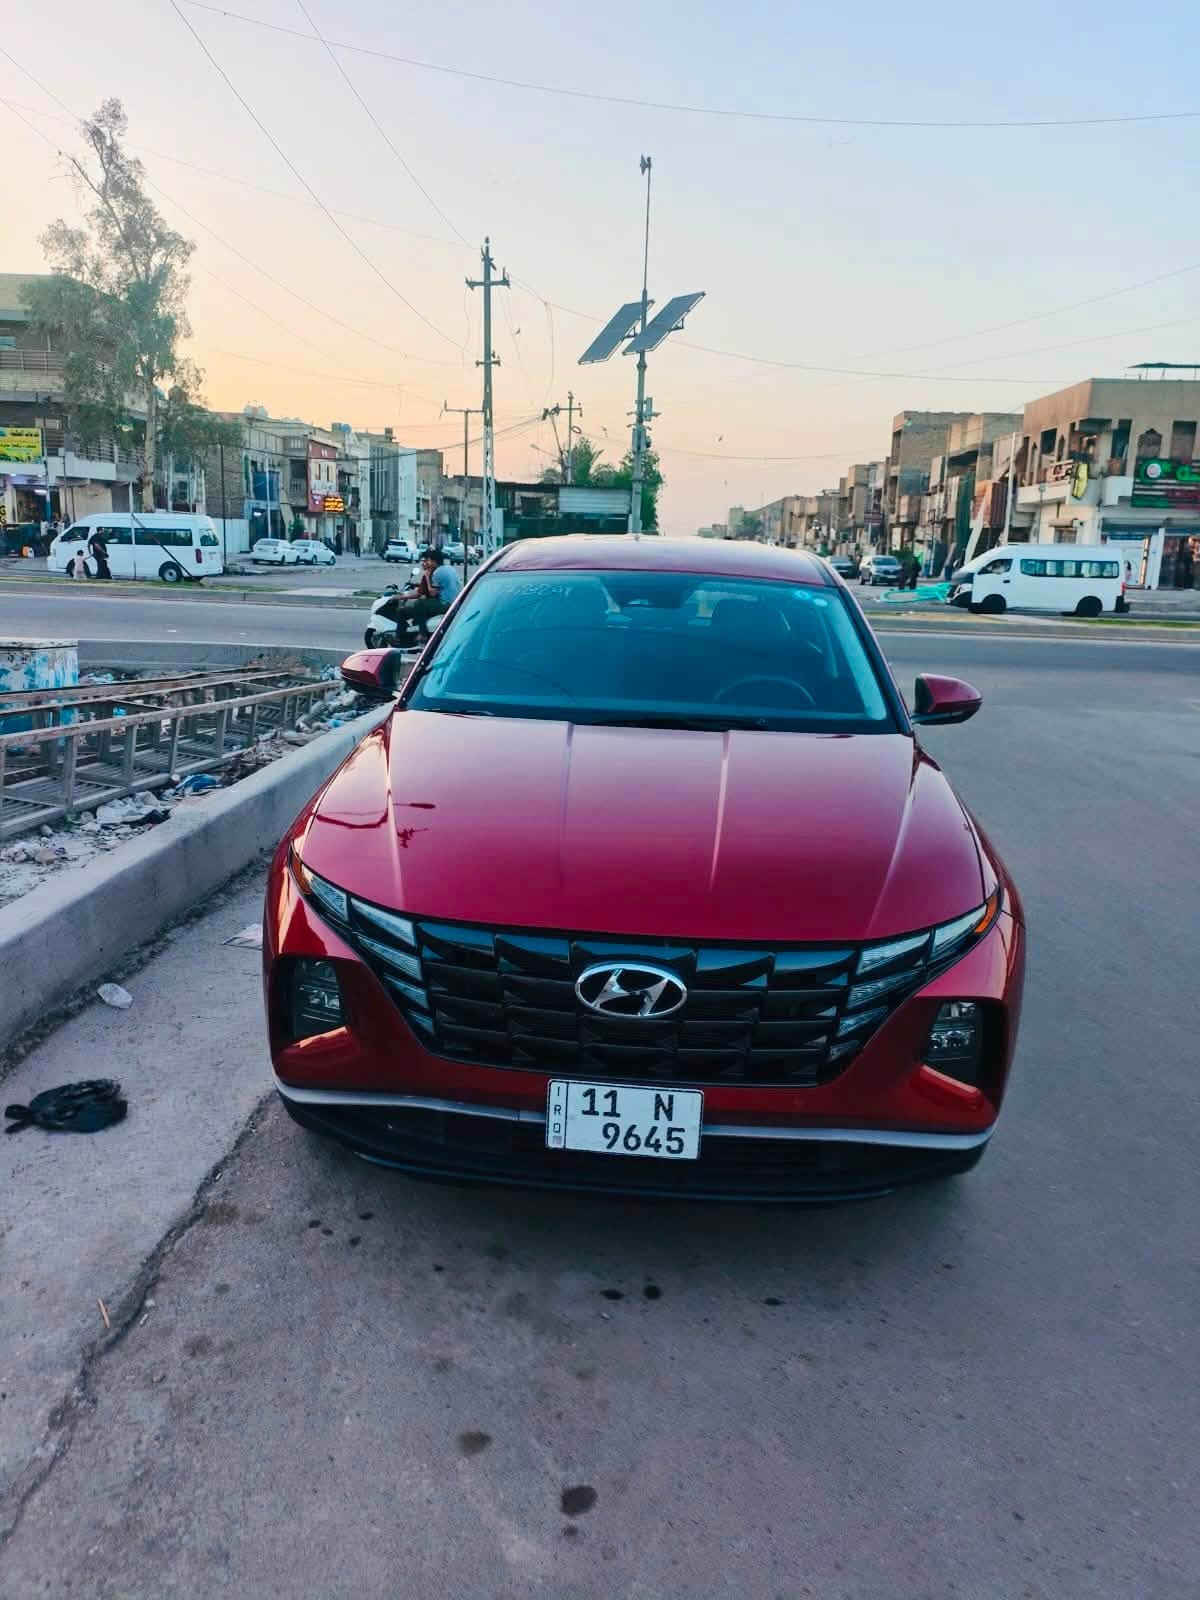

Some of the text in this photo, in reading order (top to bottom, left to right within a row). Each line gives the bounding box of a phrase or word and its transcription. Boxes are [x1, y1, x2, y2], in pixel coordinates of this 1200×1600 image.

[581, 1087, 675, 1122] 11 N
[602, 1122, 686, 1155] 9645
